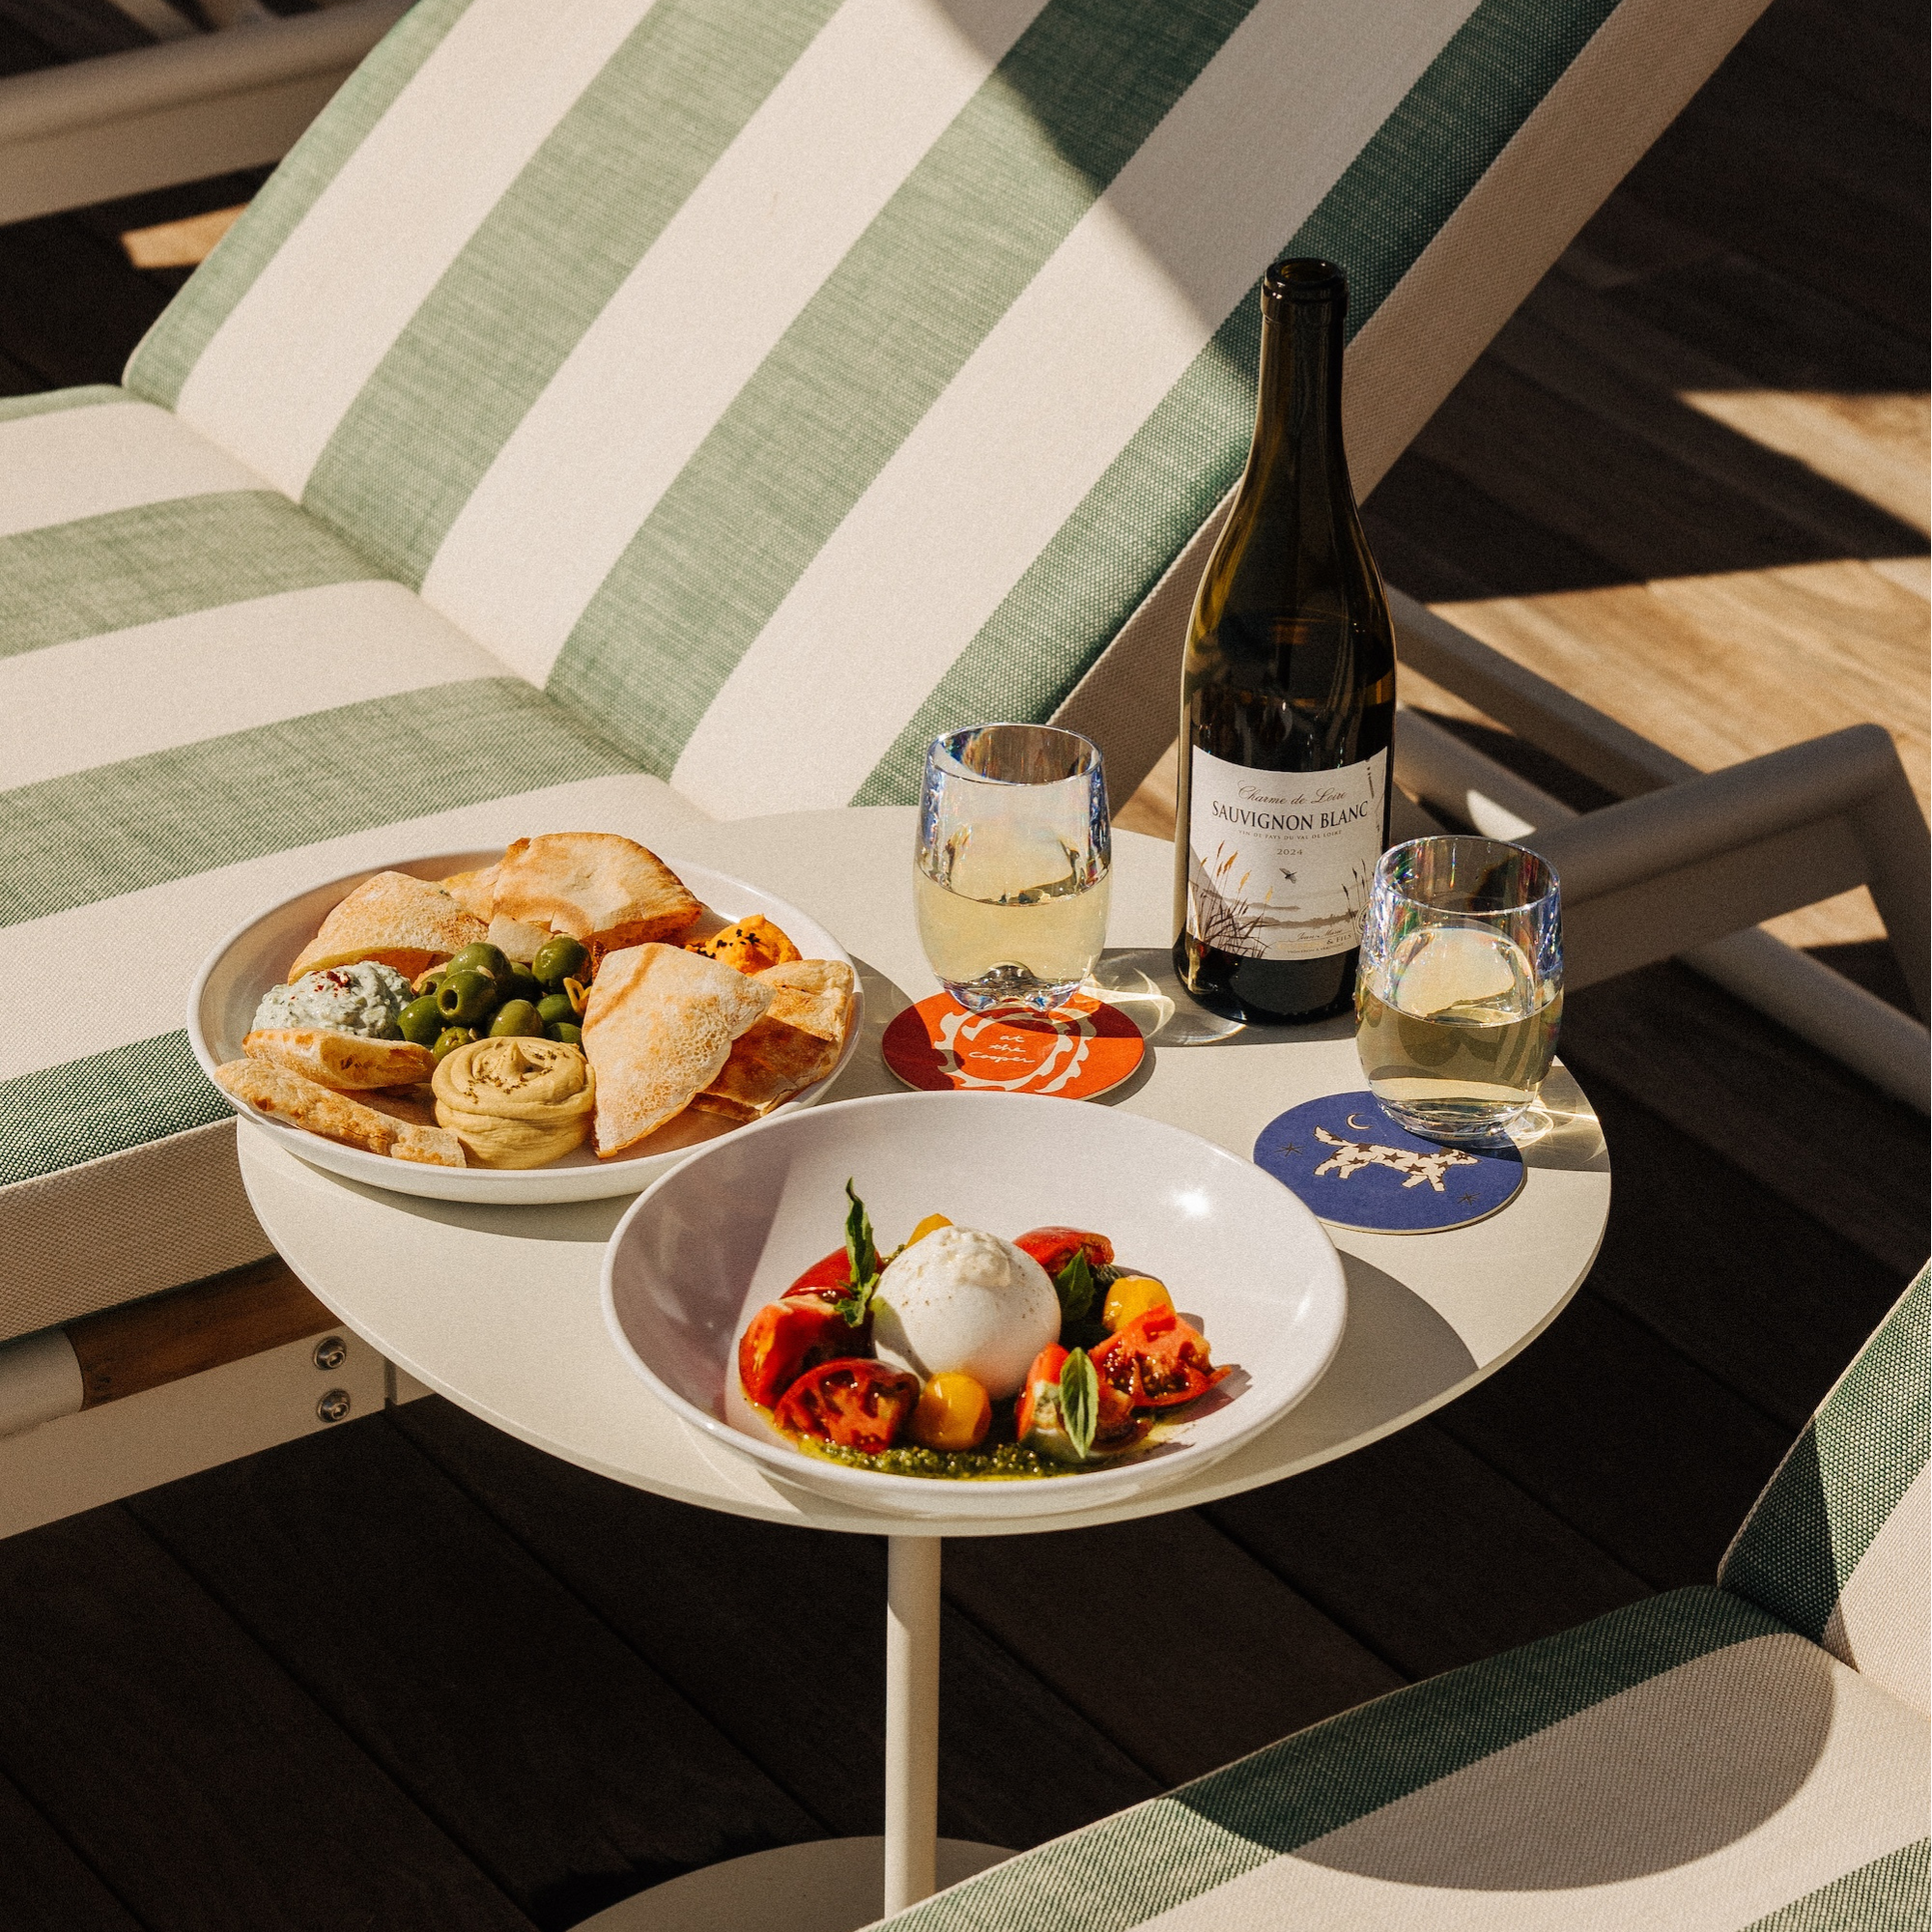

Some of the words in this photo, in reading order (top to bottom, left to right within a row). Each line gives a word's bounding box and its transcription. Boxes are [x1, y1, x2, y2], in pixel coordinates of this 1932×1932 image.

[1237, 781, 1287, 805] Charme
[1291, 793, 1306, 805] de
[1311, 786, 1347, 804] Loire
[1211, 800, 1314, 831] SAUVIGNON
[1320, 800, 1369, 829] BLANC
[1322, 829, 1343, 838] LOIRE
[1336, 934, 1351, 943] FILS
[1000, 1035, 1026, 1043] at
[988, 1043, 1027, 1053] the
